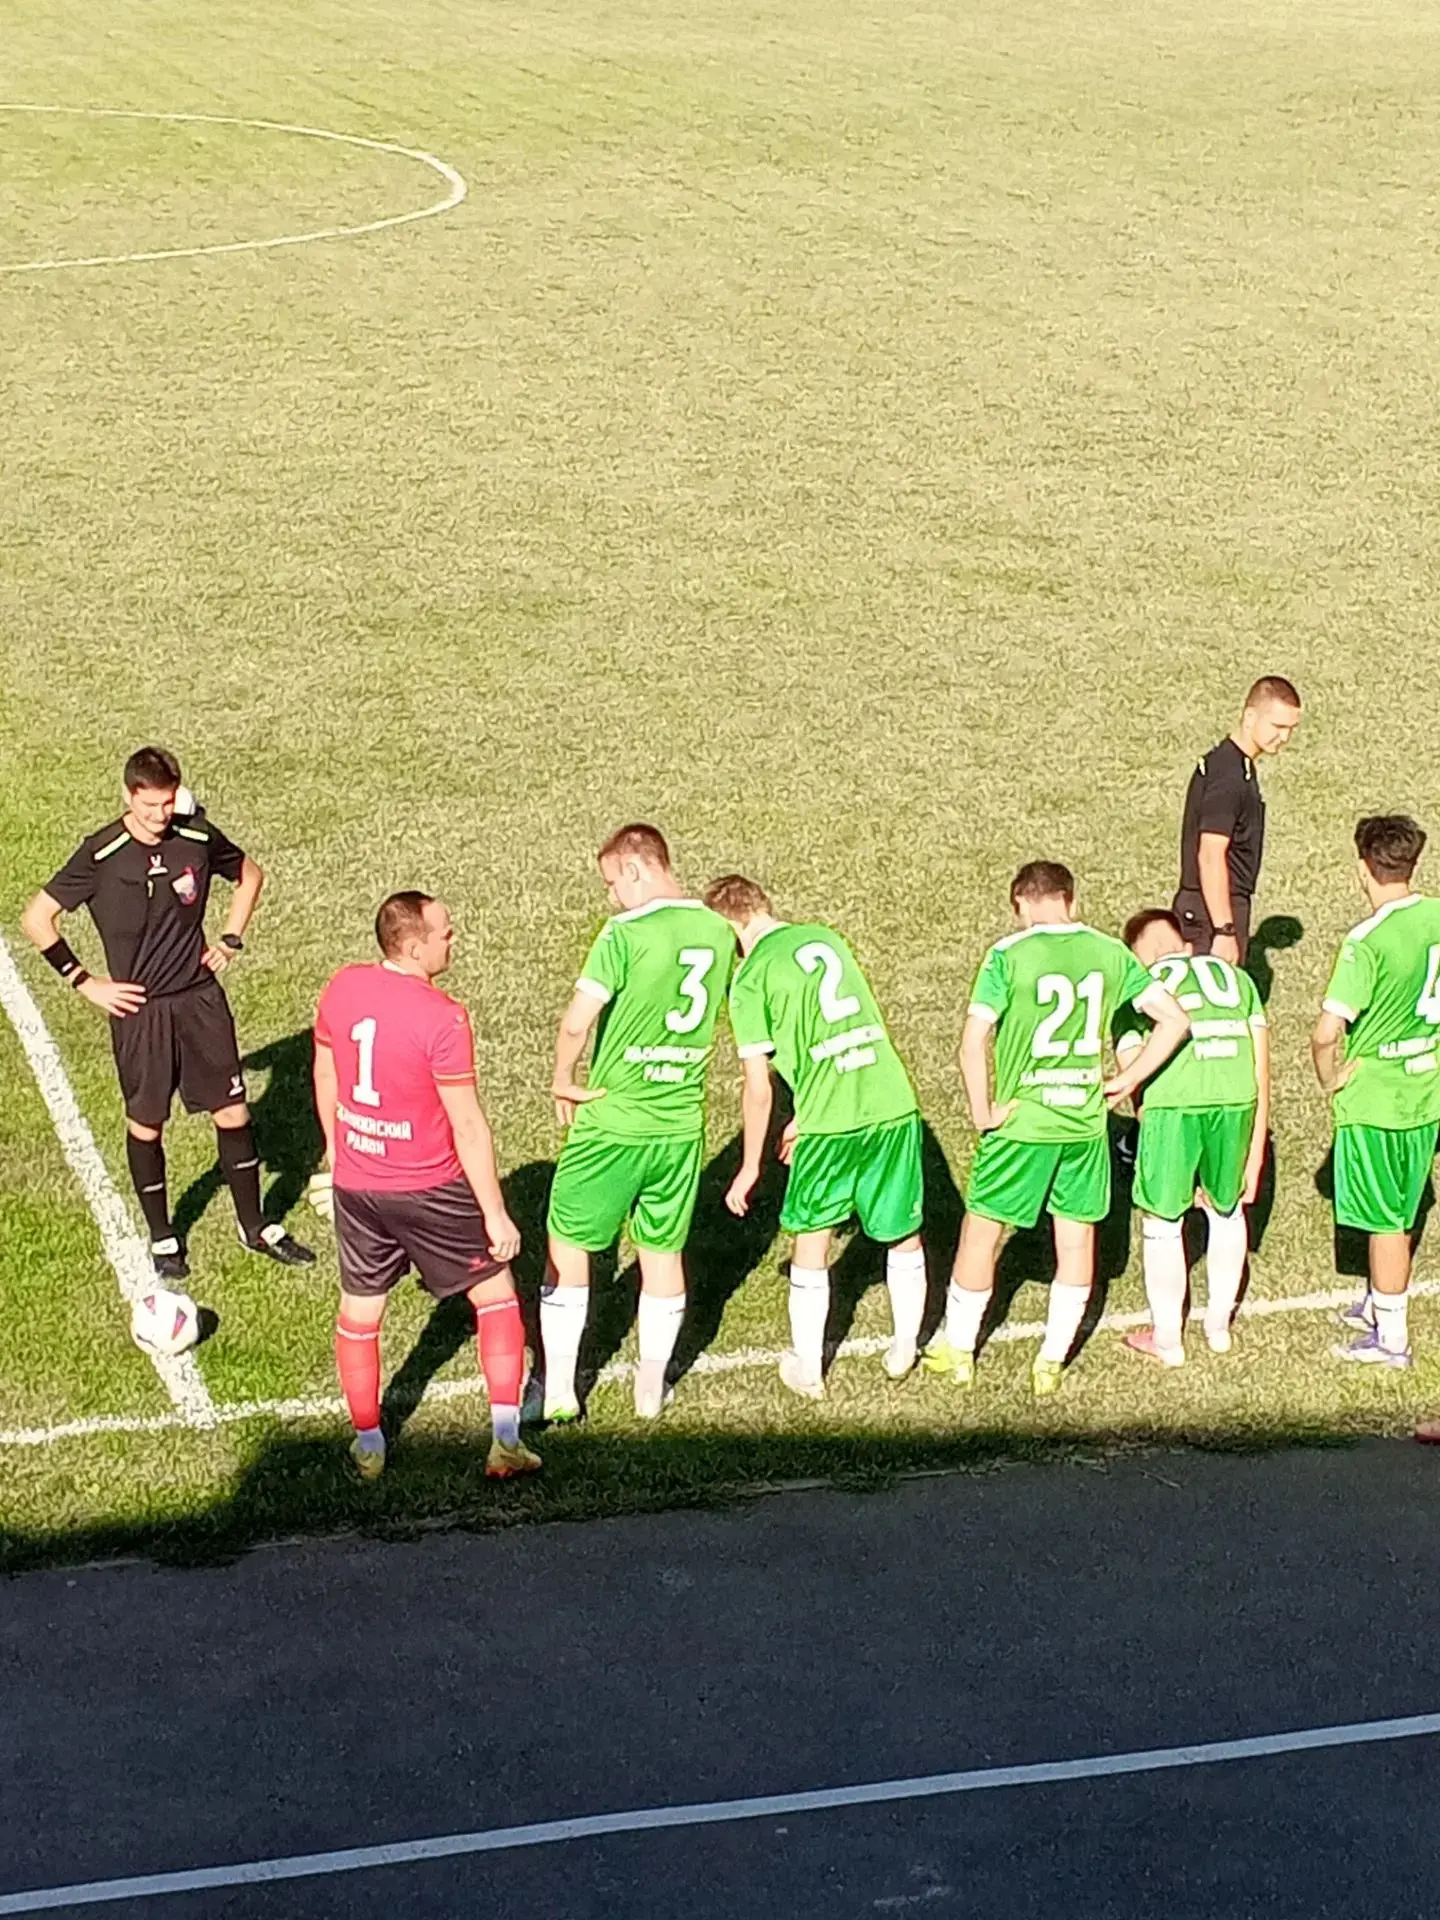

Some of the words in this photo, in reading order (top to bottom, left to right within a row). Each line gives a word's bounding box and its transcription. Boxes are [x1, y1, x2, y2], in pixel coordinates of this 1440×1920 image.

[665, 948, 715, 1034] 3
[794, 941, 861, 1024] 2
[1031, 971, 1104, 1059] 21
[1149, 955, 1241, 1009] 20
[350, 1016, 381, 1108] 1
